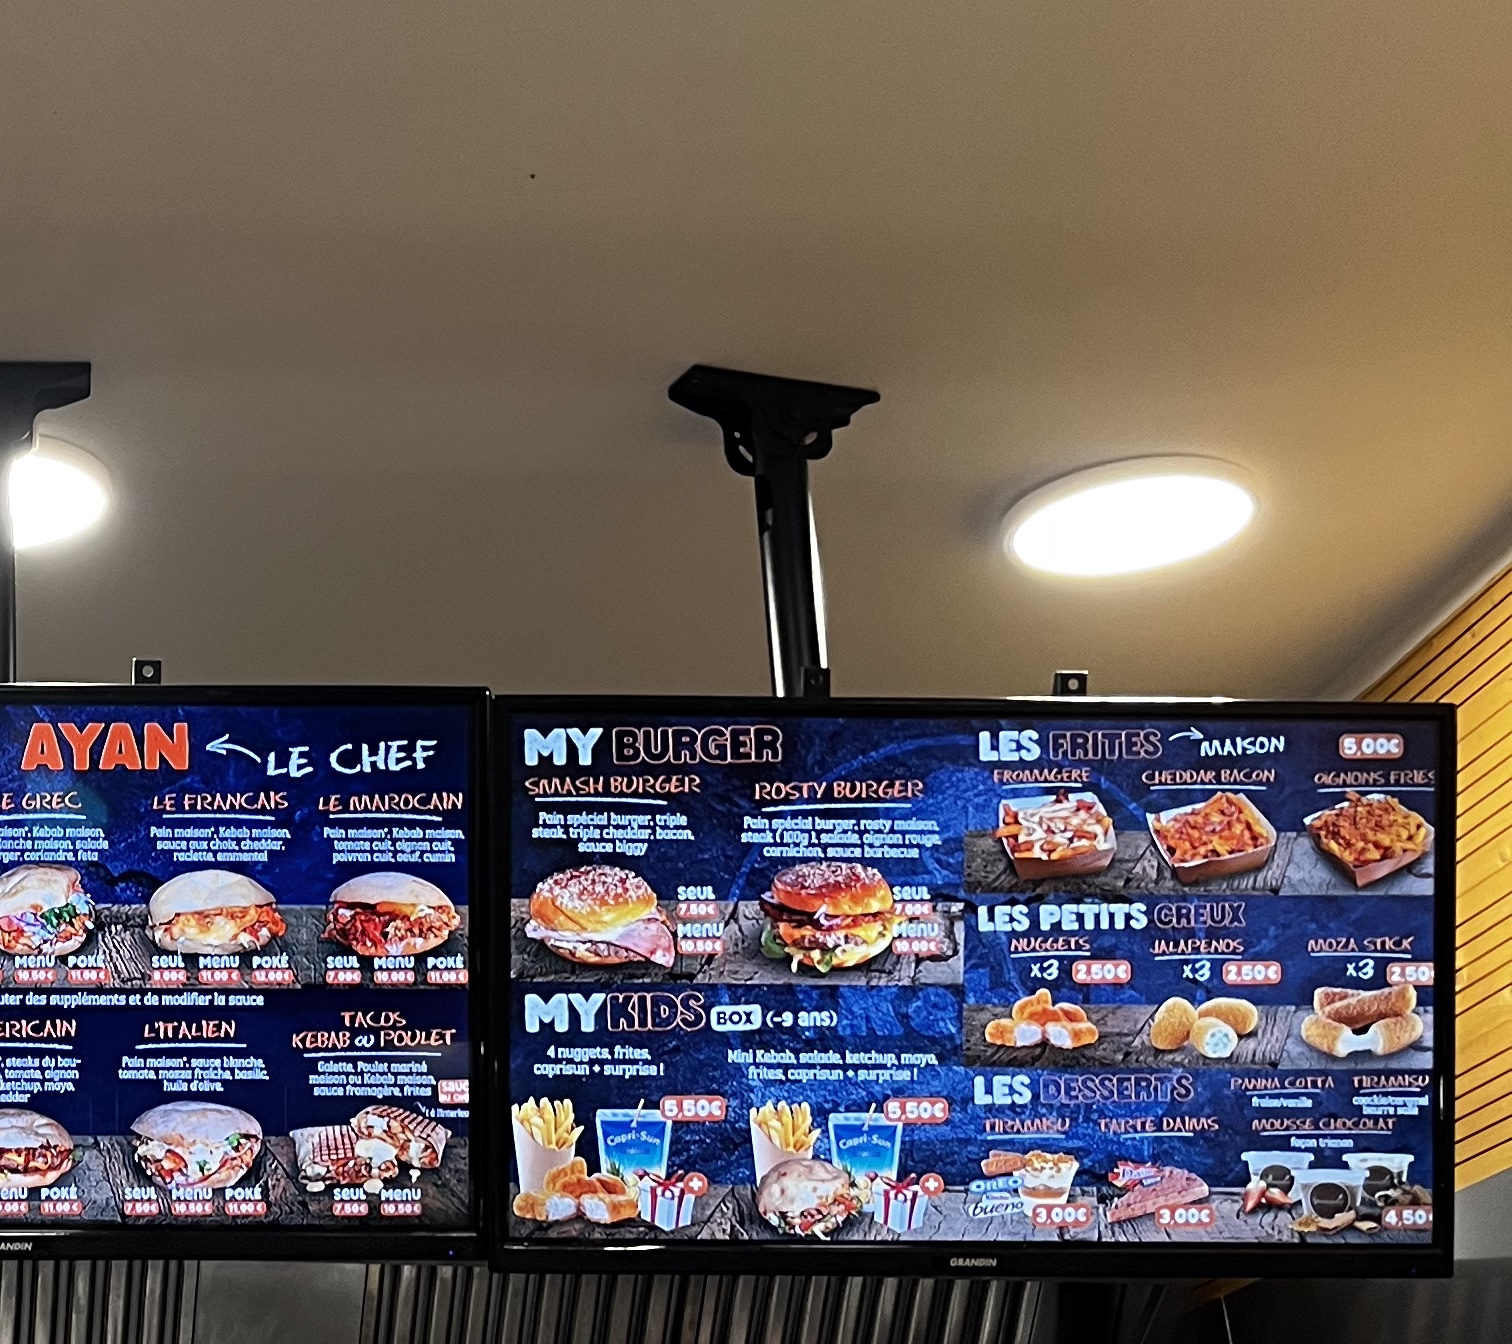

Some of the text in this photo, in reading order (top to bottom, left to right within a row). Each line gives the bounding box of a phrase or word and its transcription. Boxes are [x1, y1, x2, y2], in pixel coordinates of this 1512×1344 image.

[21, 723, 189, 772] AYAN
[524, 725, 782, 766] MY BURGER
[979, 729, 1284, 761] LES FRITES MAISON
[267, 740, 437, 777] LE CHEF
[525, 775, 700, 795] SMASH BURGER
[994, 768, 1090, 784] FROMAGERE
[1142, 769, 1274, 784] CHEDDAR BACON
[755, 780, 923, 799] ROSTY BURGER
[22, 792, 81, 810] GREC
[153, 791, 288, 810] LE FRANCAIS
[319, 792, 462, 811] LE MAROCAIN
[978, 901, 1246, 932] LES PETITS CREUX
[1011, 937, 1090, 952] NUGGETS
[1150, 939, 1244, 954] JALAPENOS
[1308, 937, 1414, 953] MOZA STICK
[26, 991, 46, 1005] des
[50, 992, 126, 1008] suppléments
[129, 994, 141, 1005] et
[144, 992, 159, 1005] de
[162, 992, 212, 1005] modifier
[214, 992, 225, 1005] la
[229, 995, 264, 1005] sauce
[341, 1012, 406, 1028] TACOS
[717, 1012, 754, 1025] BOX
[292, 1029, 456, 1049] KEBAB POULET
[974, 1073, 1194, 1106] LES DESSERTS
[1098, 1116, 1218, 1133] TARTE DAIMS
[1252, 1118, 1396, 1131] MOUSSE CHOCOLAT
